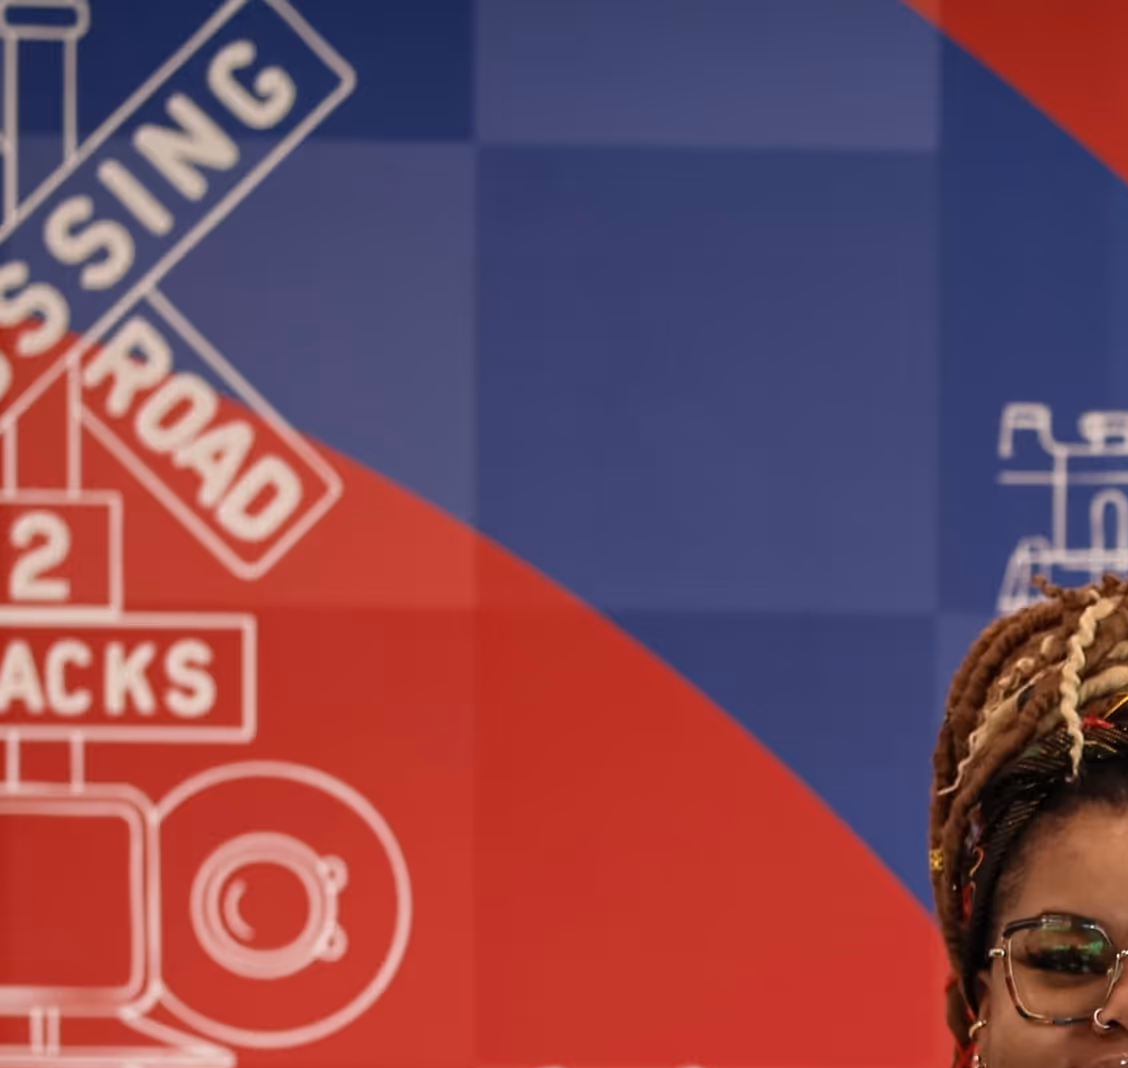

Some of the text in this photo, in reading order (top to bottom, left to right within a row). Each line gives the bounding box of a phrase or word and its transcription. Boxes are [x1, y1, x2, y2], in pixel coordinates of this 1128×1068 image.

[0, 41, 296, 397] SSING
[81, 316, 304, 542] ROAD
[9, 509, 71, 602] 2
[0, 639, 217, 718] ACKS
